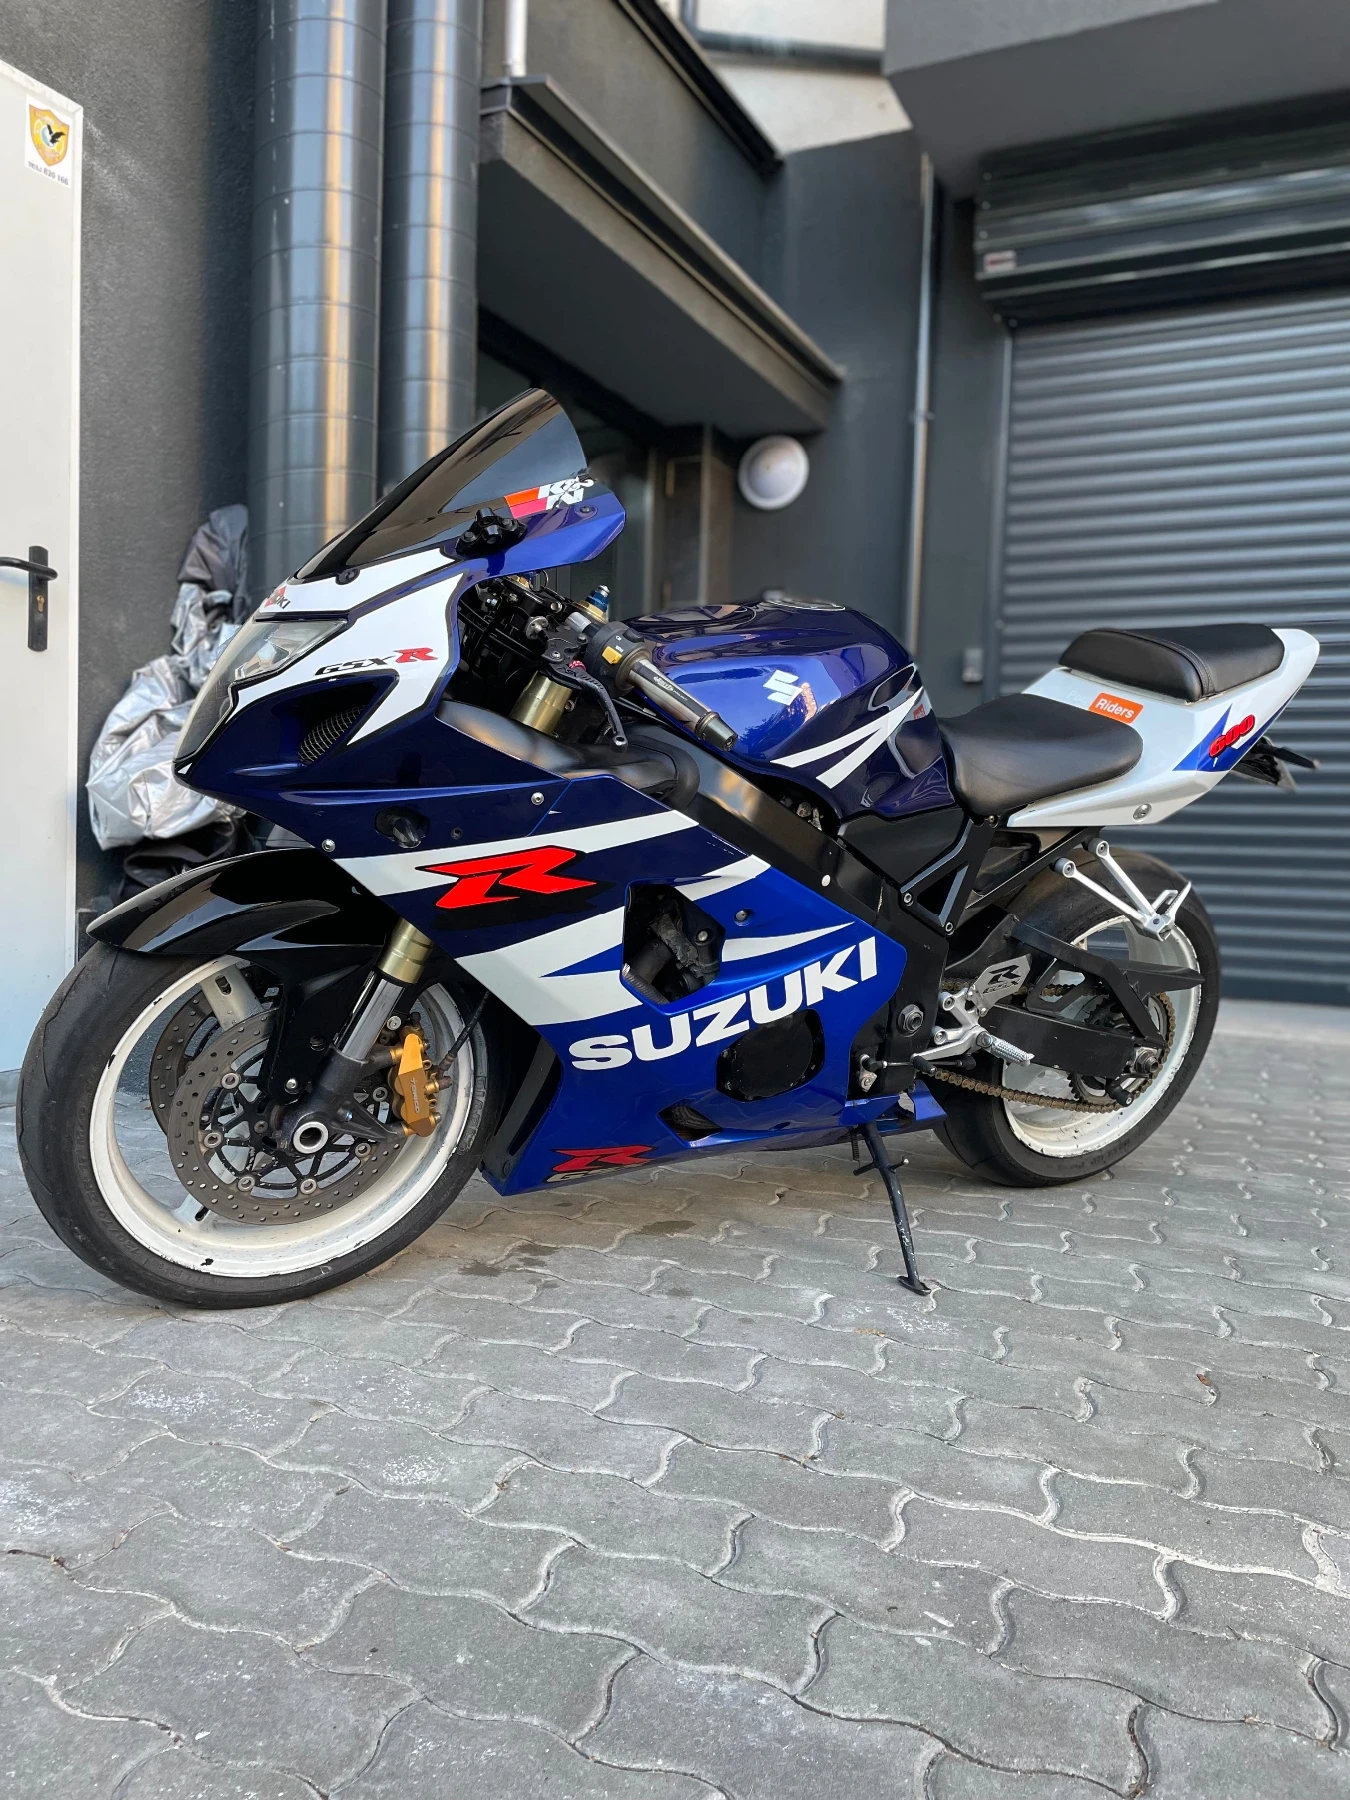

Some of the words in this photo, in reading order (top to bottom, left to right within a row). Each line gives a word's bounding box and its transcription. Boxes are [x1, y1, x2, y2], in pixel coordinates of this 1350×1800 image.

[1096, 699, 1134, 719] Riders
[1208, 714, 1256, 758] 600
[568, 936, 877, 1071] SUZUKI
